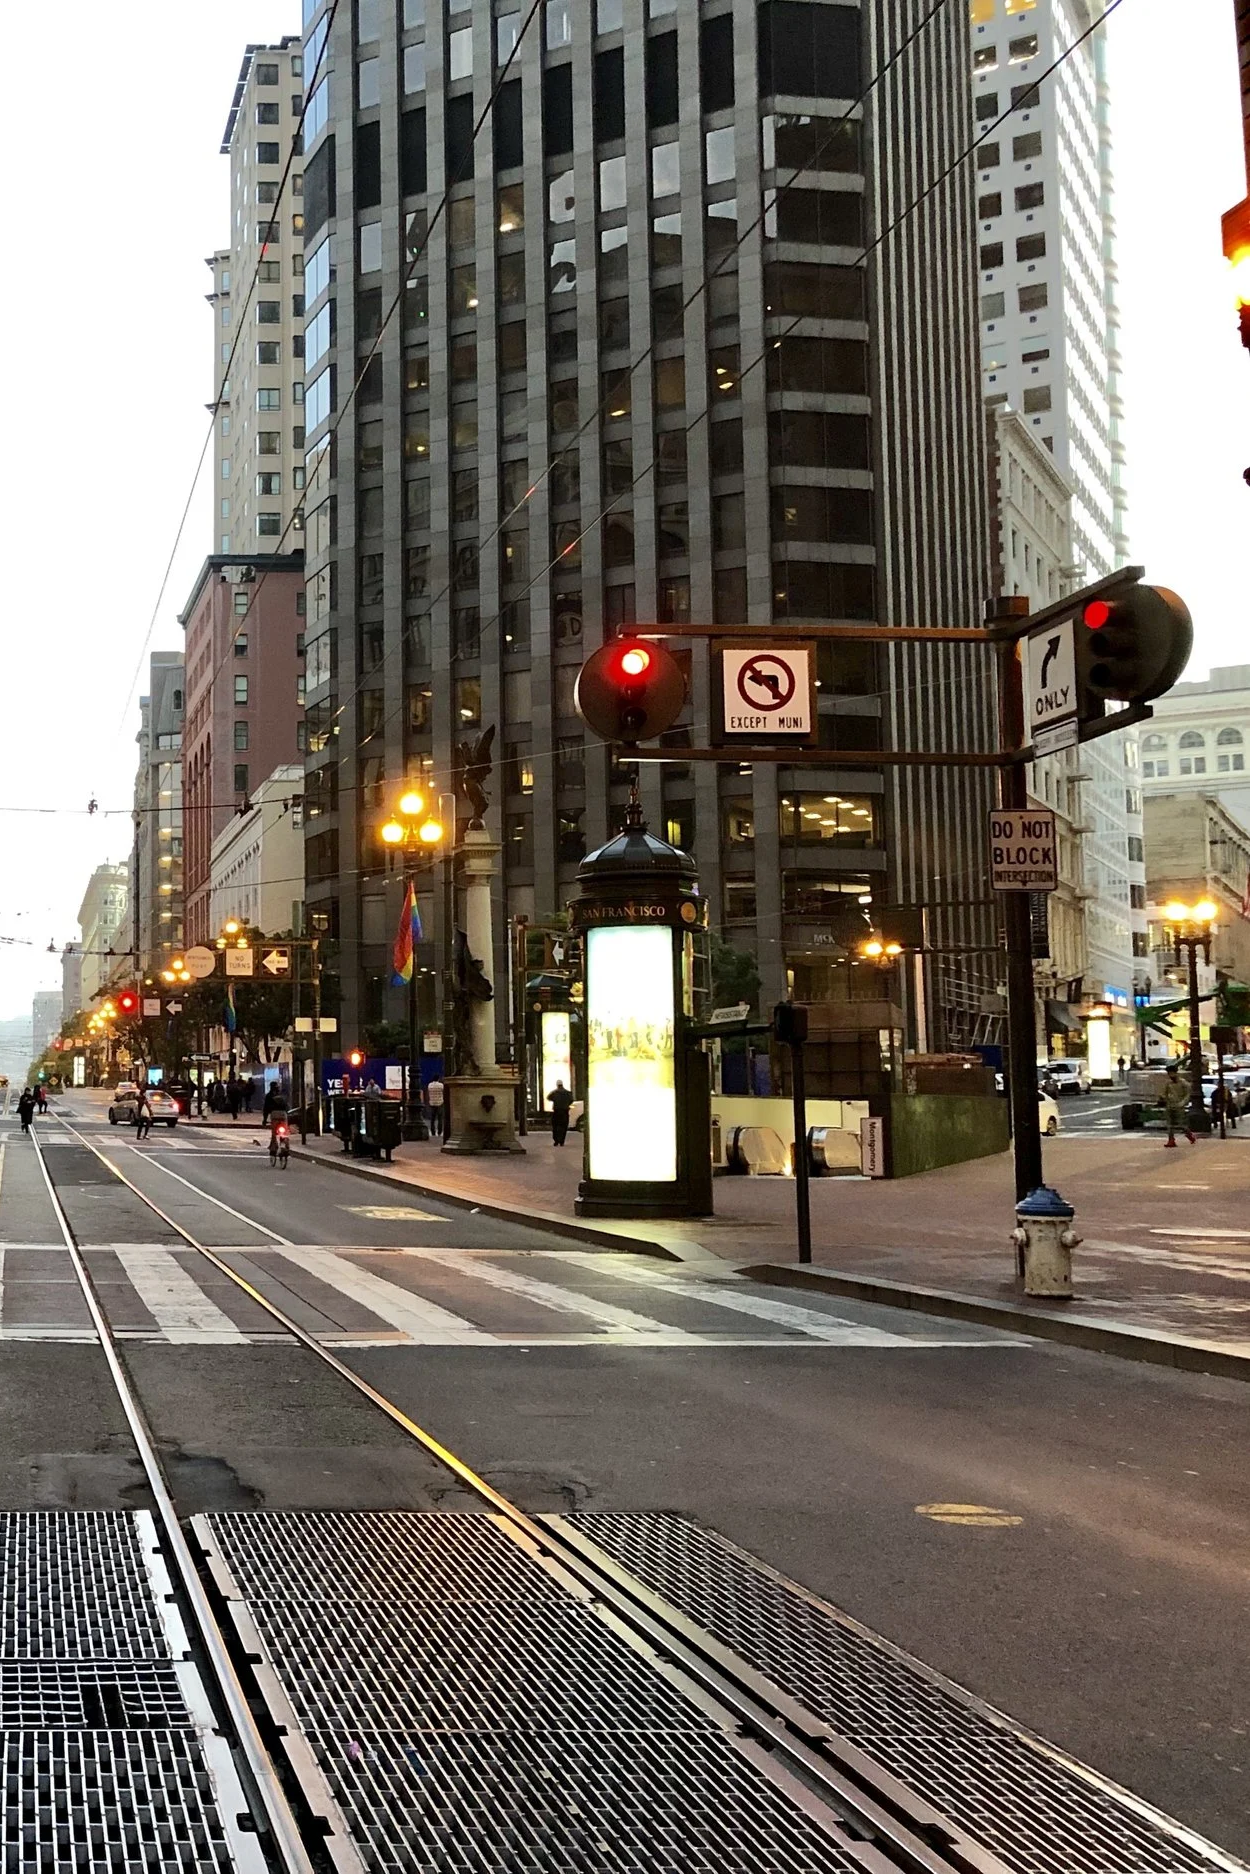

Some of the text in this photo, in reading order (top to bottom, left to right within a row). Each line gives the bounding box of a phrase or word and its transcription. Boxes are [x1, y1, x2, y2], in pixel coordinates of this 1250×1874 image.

[1036, 686, 1070, 715] ONLY
[730, 716, 803, 729] EXCEPT MUNI
[992, 821, 1050, 839] DO NOT
[993, 847, 1052, 865] BLOCK
[994, 870, 1054, 883] INTERSECTION
[582, 905, 666, 919] SAN FRANCISCO
[867, 1121, 877, 1173] Montgomery
